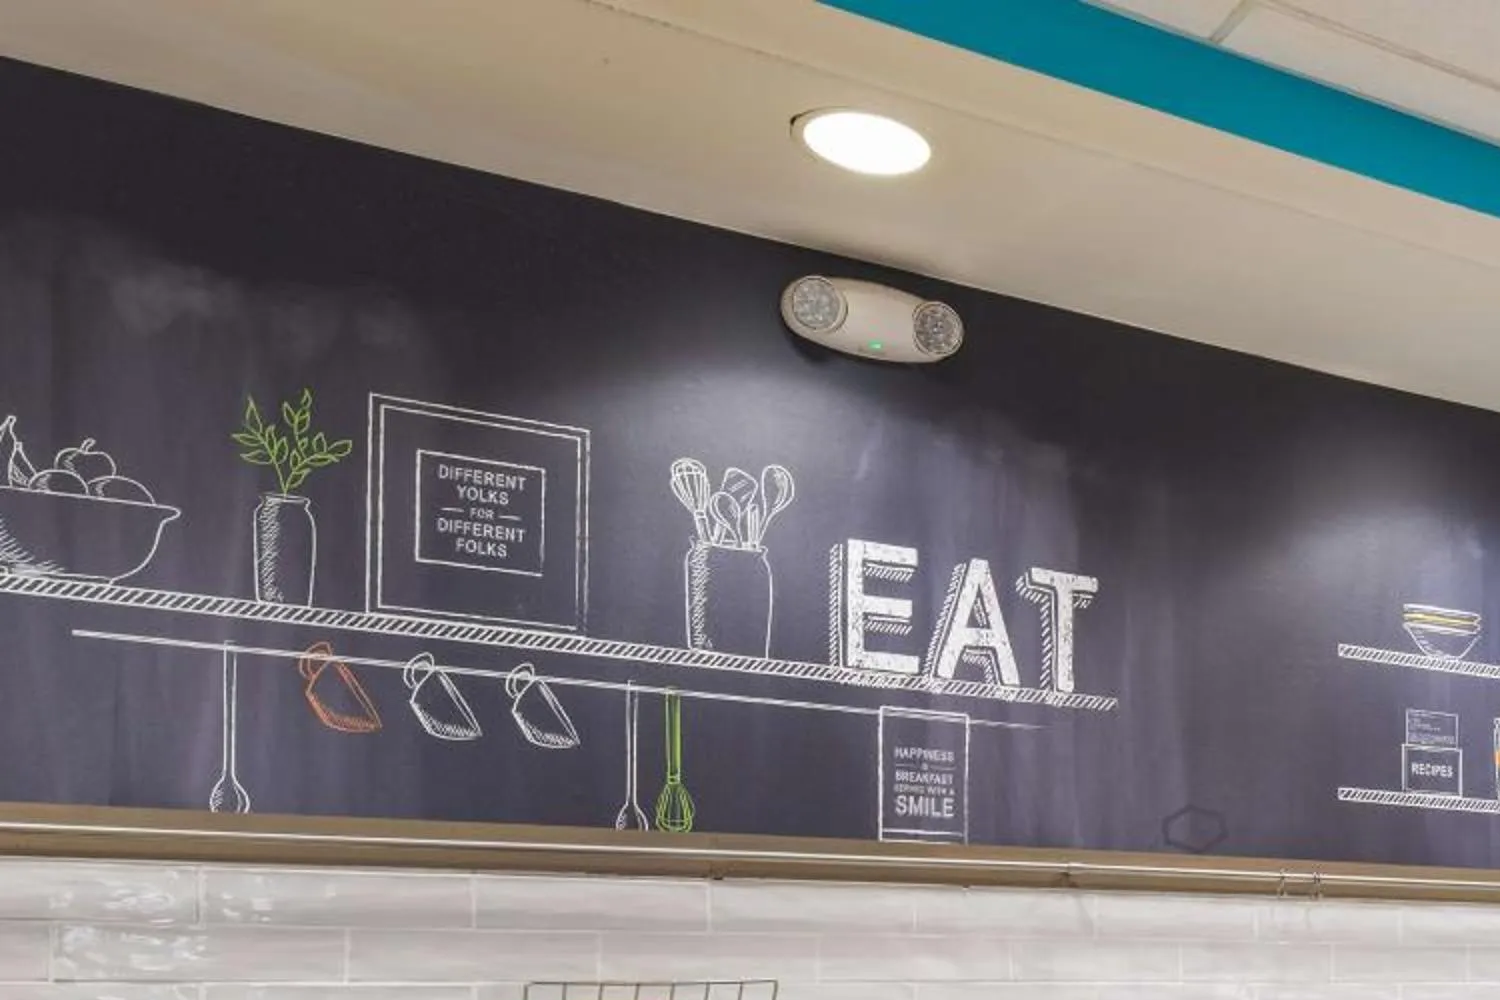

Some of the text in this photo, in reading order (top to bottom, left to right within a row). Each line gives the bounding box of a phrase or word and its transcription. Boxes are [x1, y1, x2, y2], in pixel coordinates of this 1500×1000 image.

[438, 463, 527, 491] DIFFERENT
[456, 484, 510, 505] YOLKS
[469, 507, 494, 519] FOR
[436, 517, 526, 543] DIFFERENT
[455, 537, 508, 558] FOLKS
[829, 538, 1099, 692] EAT
[895, 746, 954, 762] HAPPINESS
[895, 770, 953, 785] BREAKFAST
[1411, 762, 1453, 779] RECIPES
[895, 795, 955, 818] SMILE
